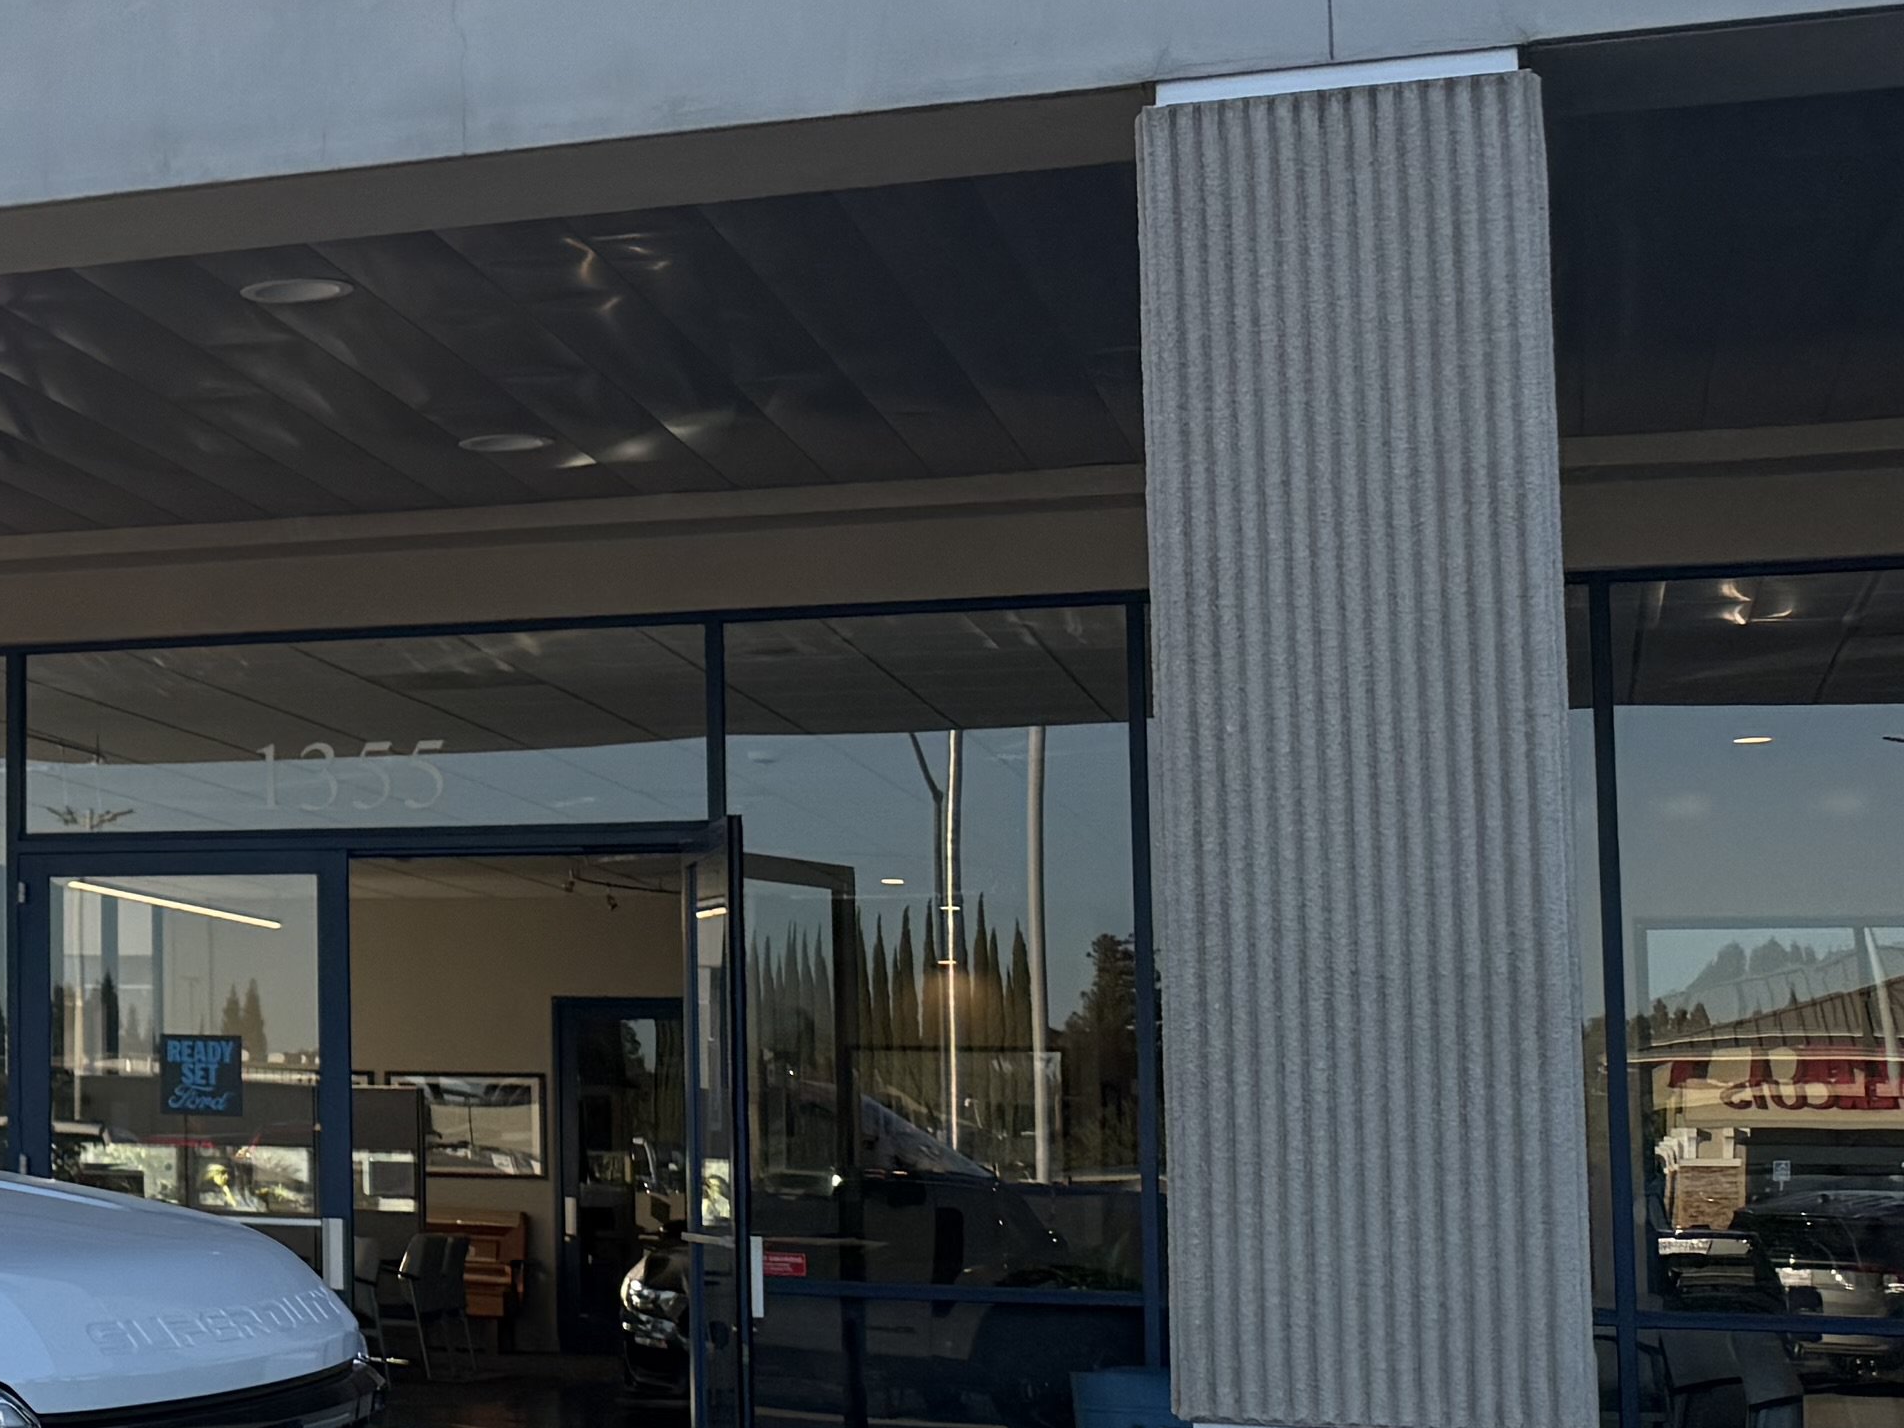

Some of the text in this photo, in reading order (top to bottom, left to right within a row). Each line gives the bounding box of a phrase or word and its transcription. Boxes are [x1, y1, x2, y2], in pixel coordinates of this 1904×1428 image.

[256, 739, 445, 811] 1355
[167, 1039, 234, 1063] READY
[181, 1063, 220, 1085] SET
[168, 1084, 236, 1111] Ford
